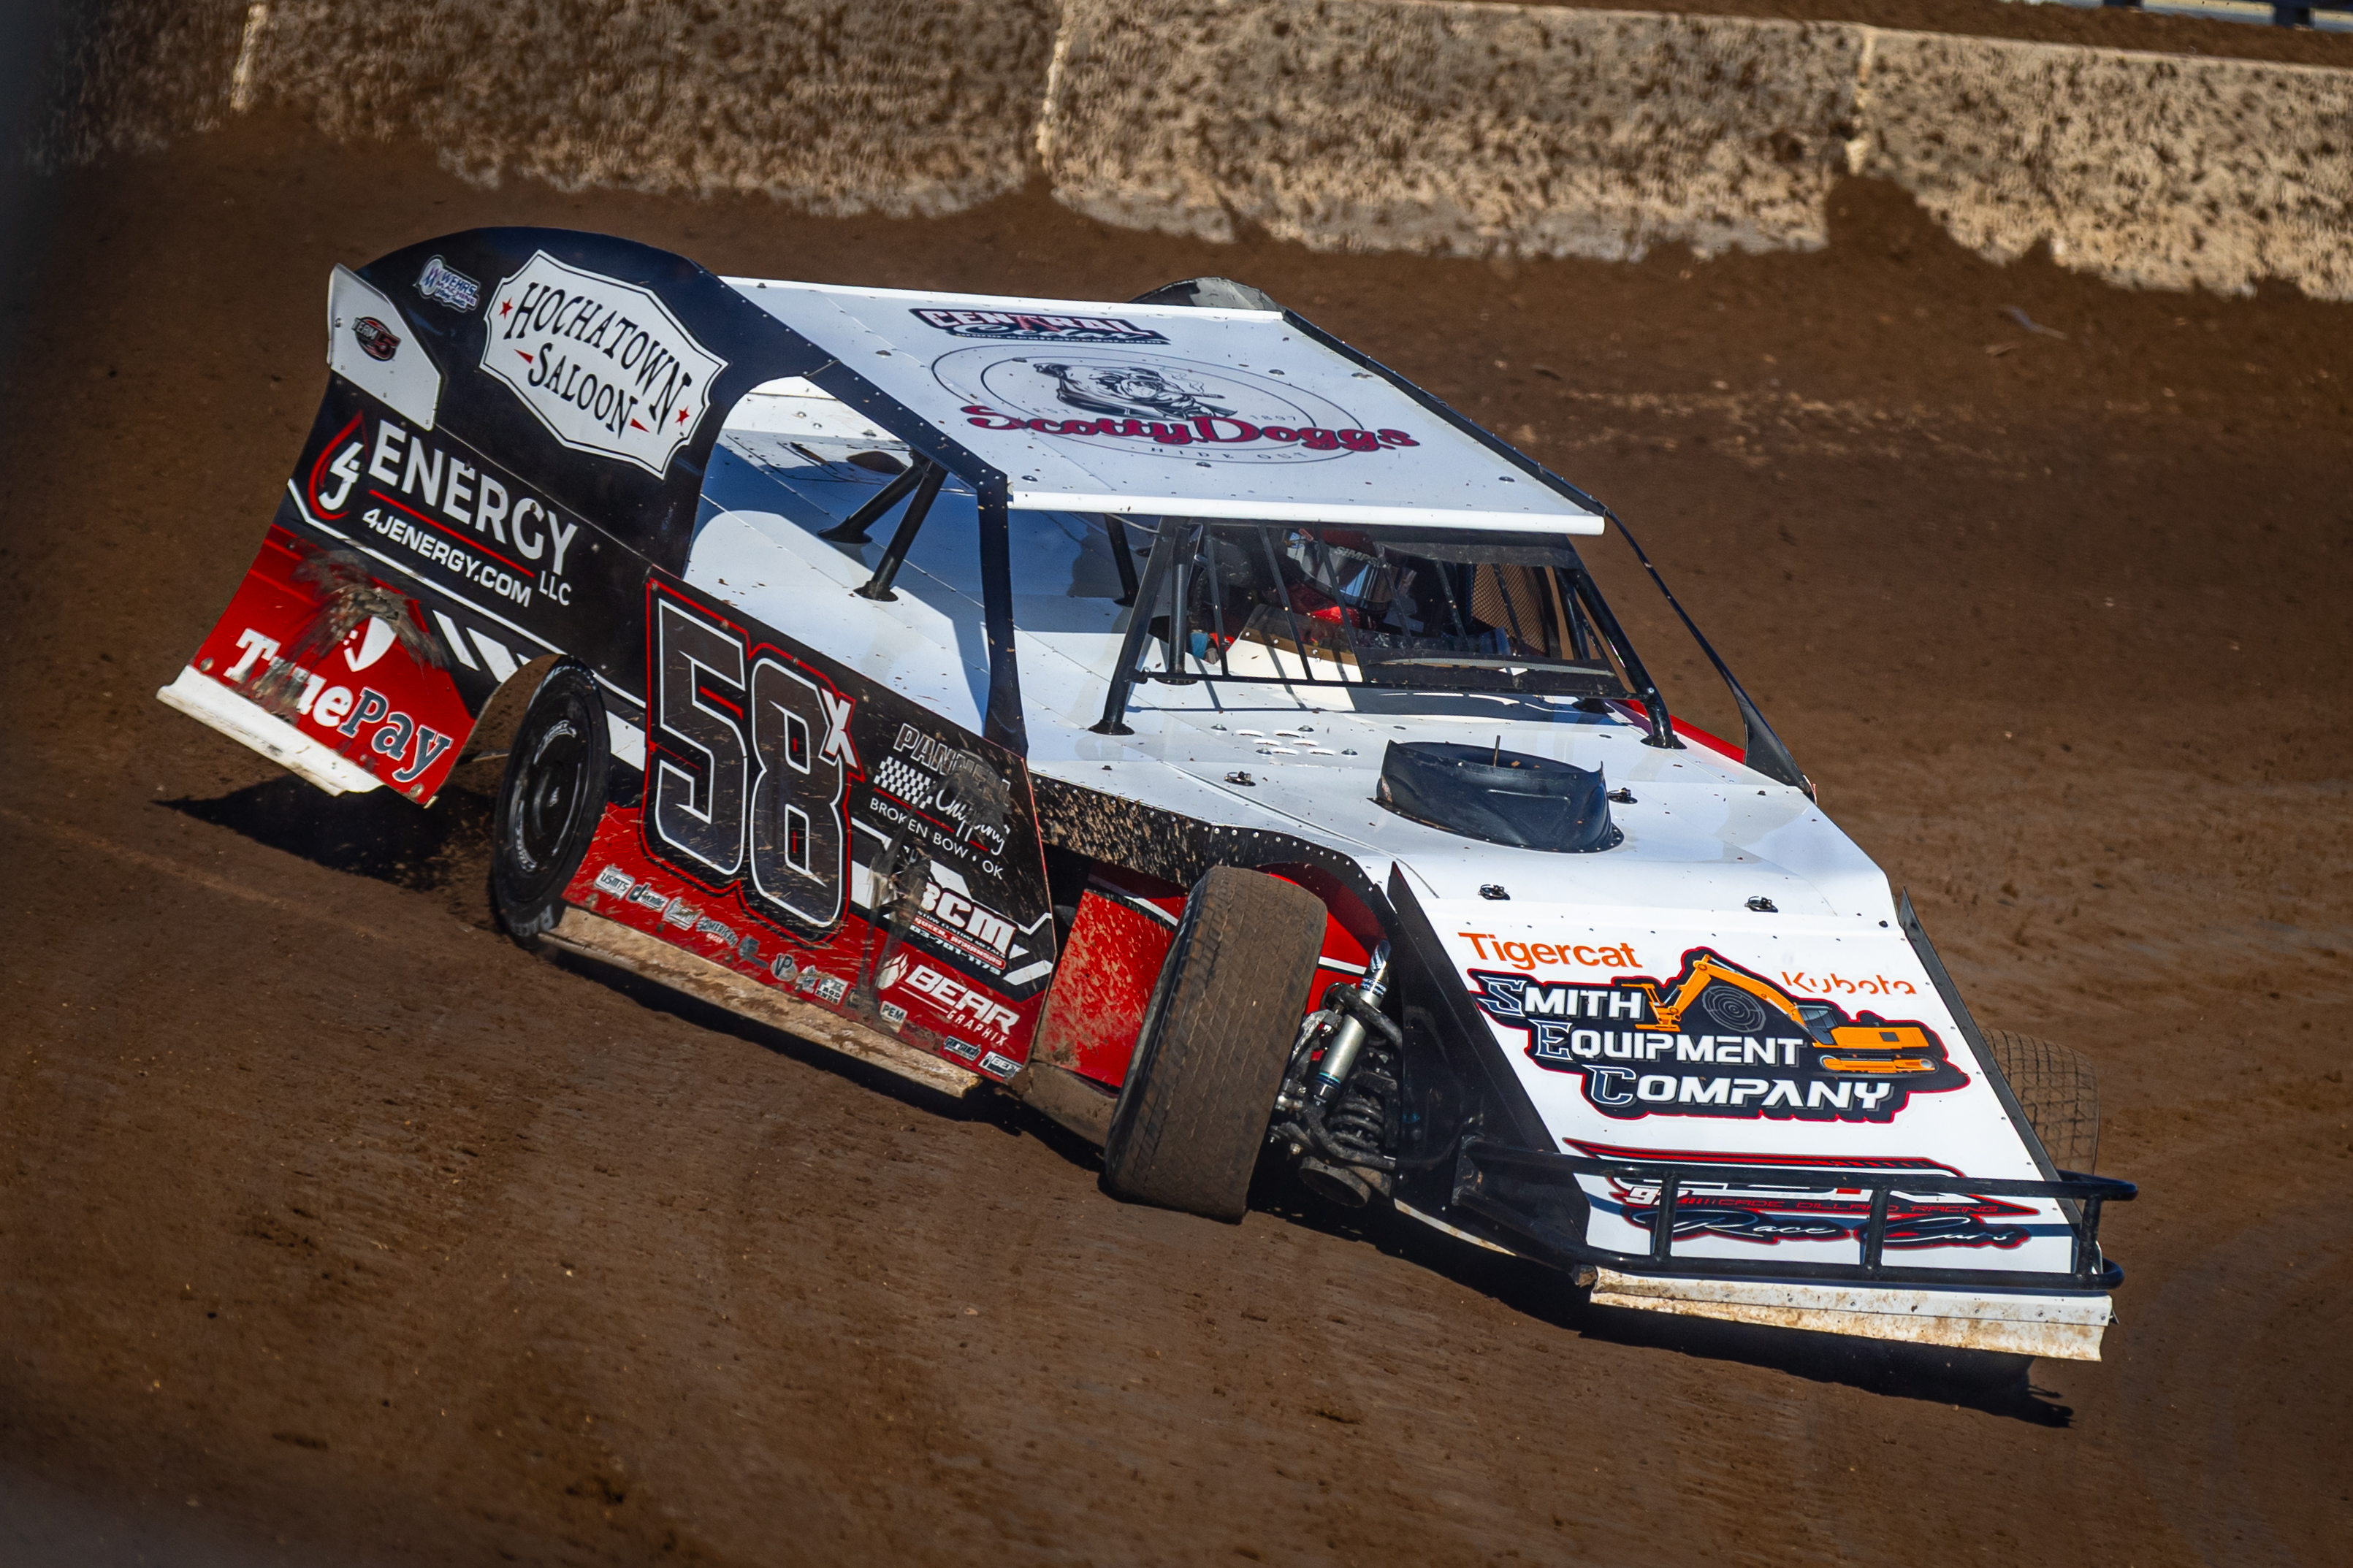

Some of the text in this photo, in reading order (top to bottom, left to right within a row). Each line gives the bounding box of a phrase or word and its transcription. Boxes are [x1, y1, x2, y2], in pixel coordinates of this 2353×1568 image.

[441, 271, 476, 297] WEHRS
[351, 317, 401, 358] TEAM 5
[918, 310, 1154, 336] CENTRAL
[503, 280, 692, 435] HOCHATOWN
[527, 342, 640, 439] SALOON
[367, 418, 579, 575] ENERGY
[362, 508, 533, 607] 4JENERGY.COM
[538, 570, 572, 606] LLC
[869, 798, 1004, 880] BROKEN BOW OK
[1457, 932, 1643, 970] Tigercat
[815, 990, 839, 1004] ENDS
[823, 986, 841, 998] ROD
[905, 964, 1020, 1035] BEAR
[1477, 975, 1642, 1019] SMITH
[1780, 970, 1917, 995] Kubota
[882, 1004, 904, 1021] PEM
[947, 1009, 1009, 1047] GRAPHIX
[1528, 1018, 1804, 1066] EQUIPMENT
[1582, 1064, 1891, 1109] COMPANY
[1718, 1198, 1785, 1208] CADE
[1910, 1205, 1999, 1214] RACING
[1633, 1209, 2016, 1242] Race Cars
